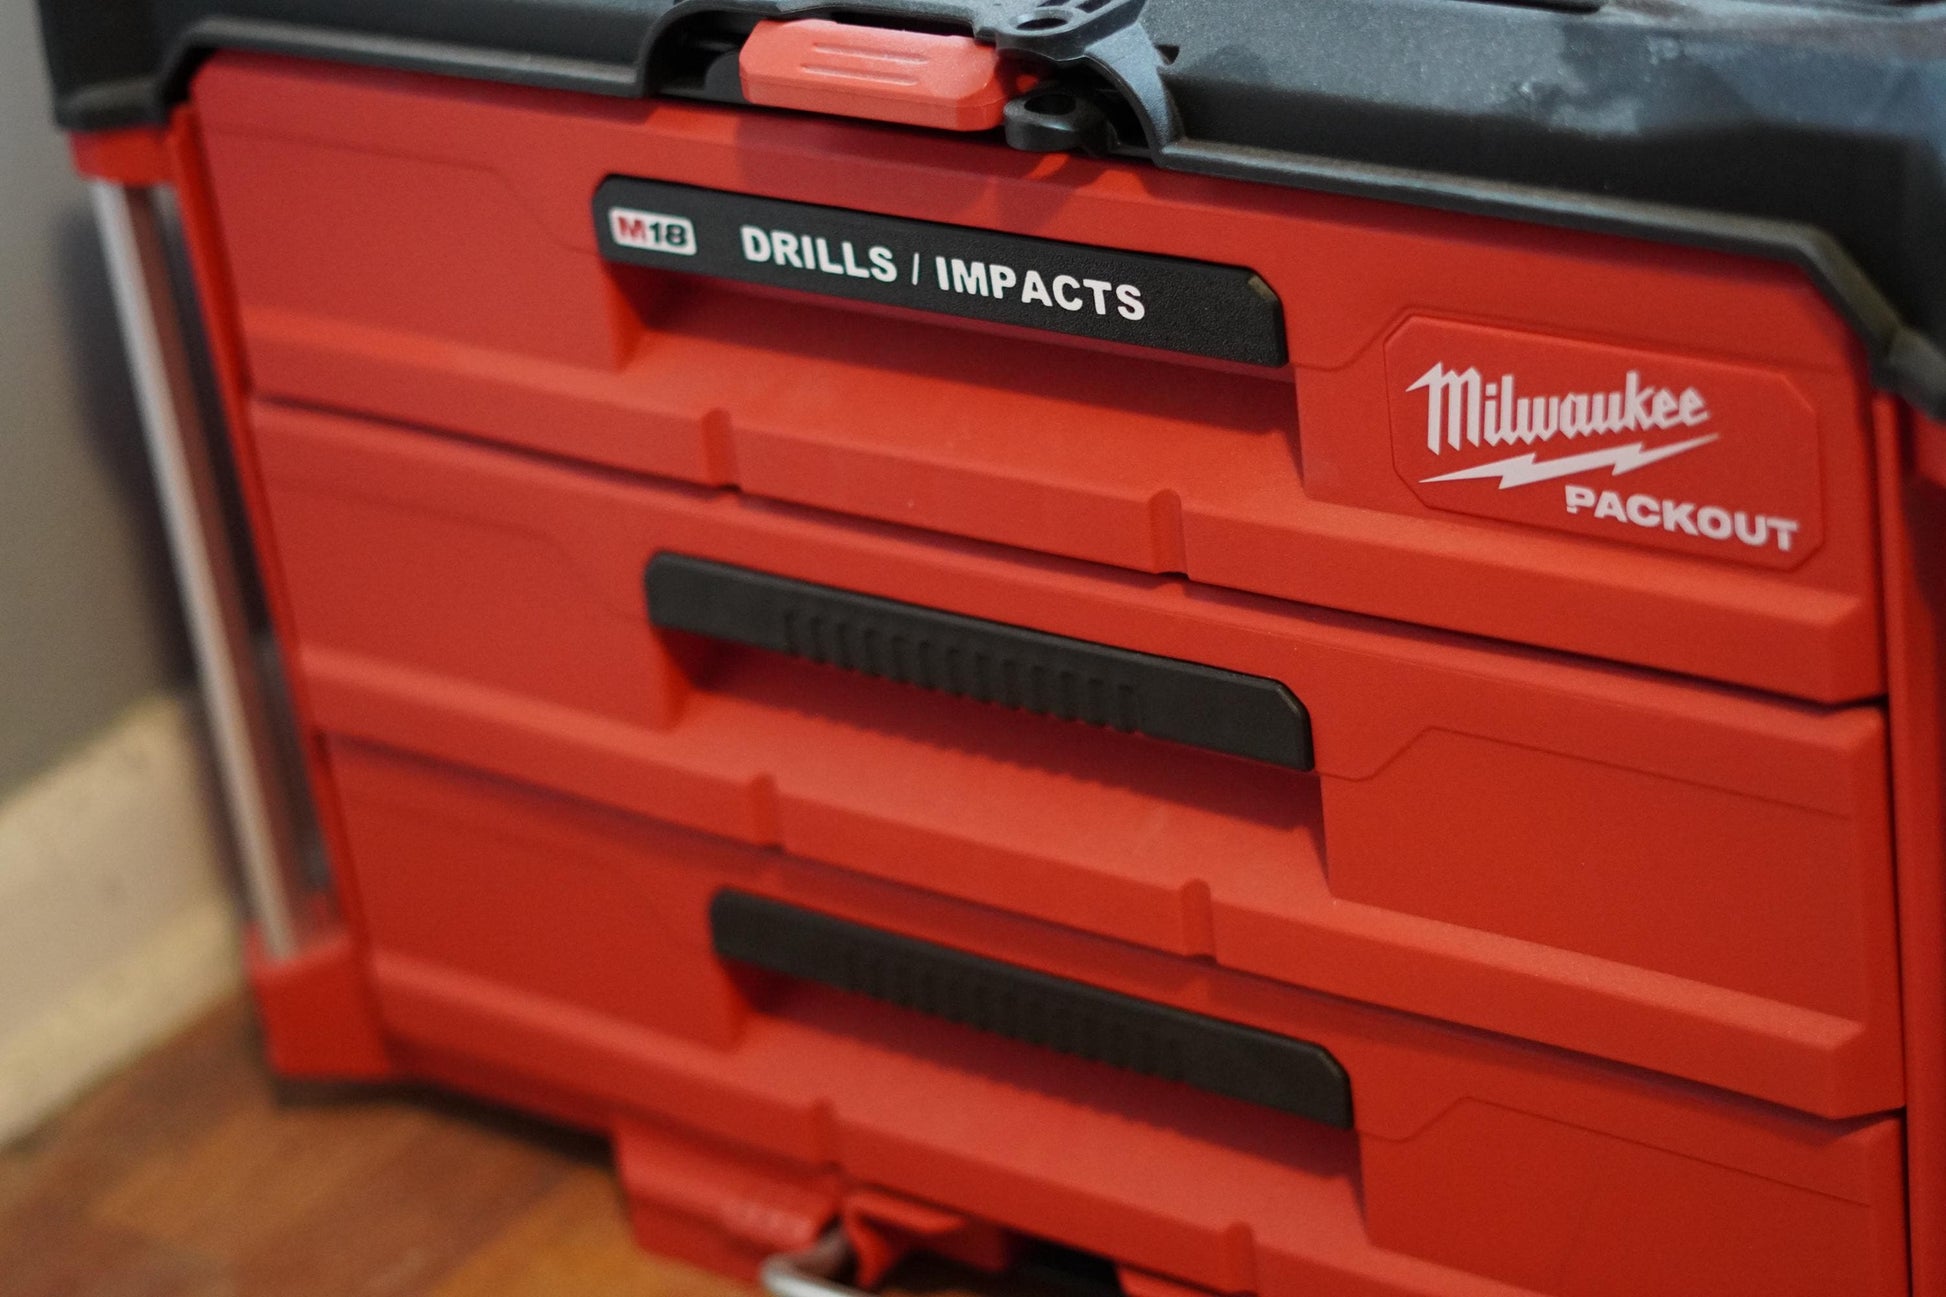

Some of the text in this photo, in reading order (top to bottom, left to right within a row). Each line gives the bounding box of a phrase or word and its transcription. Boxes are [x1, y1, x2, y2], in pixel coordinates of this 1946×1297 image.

[616, 214, 1146, 321] M18 DRILLS / IMPACTS
[1405, 361, 1710, 455] Milwaukee
[1565, 484, 1799, 551] PACKOUT
